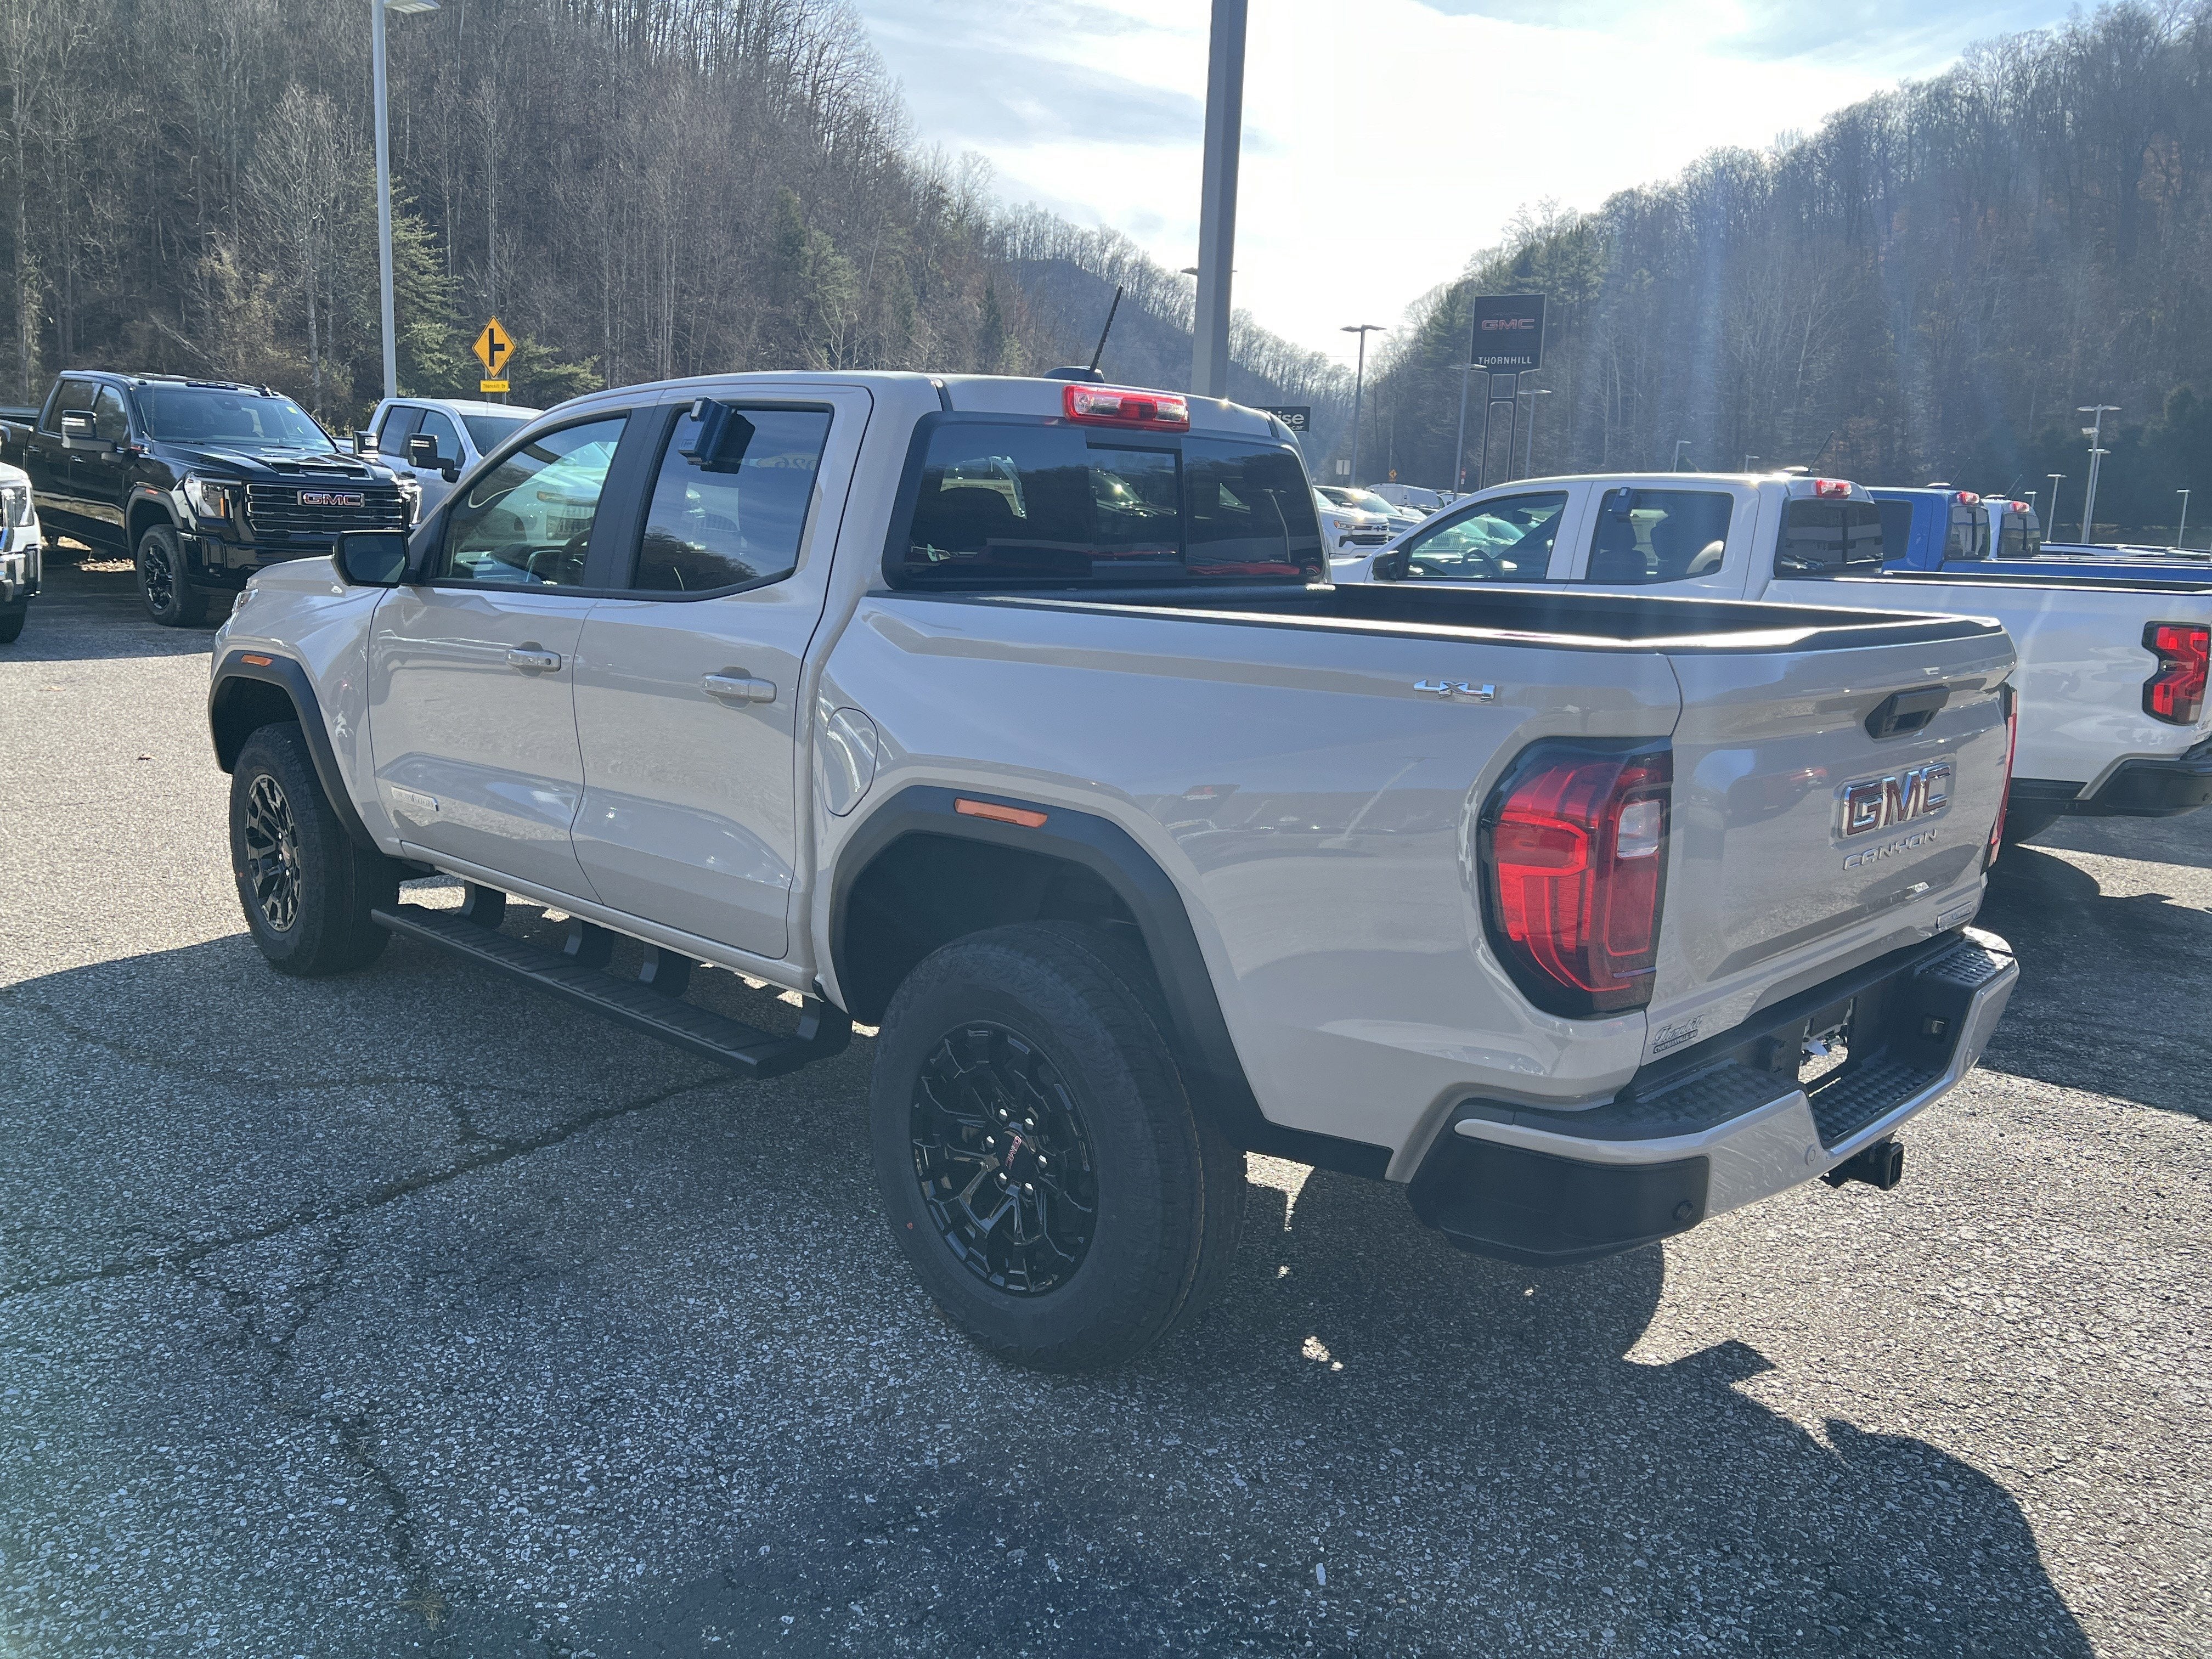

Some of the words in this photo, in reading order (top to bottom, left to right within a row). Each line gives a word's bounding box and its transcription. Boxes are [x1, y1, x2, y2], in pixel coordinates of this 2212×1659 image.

[1482, 319, 1535, 331] GMC
[1478, 356, 1532, 364] THORNHILL
[303, 493, 362, 506] GMC
[1838, 762, 1950, 838] GMC
[1842, 828, 1938, 870] CANYON
[1005, 1136, 1022, 1170] GMC
